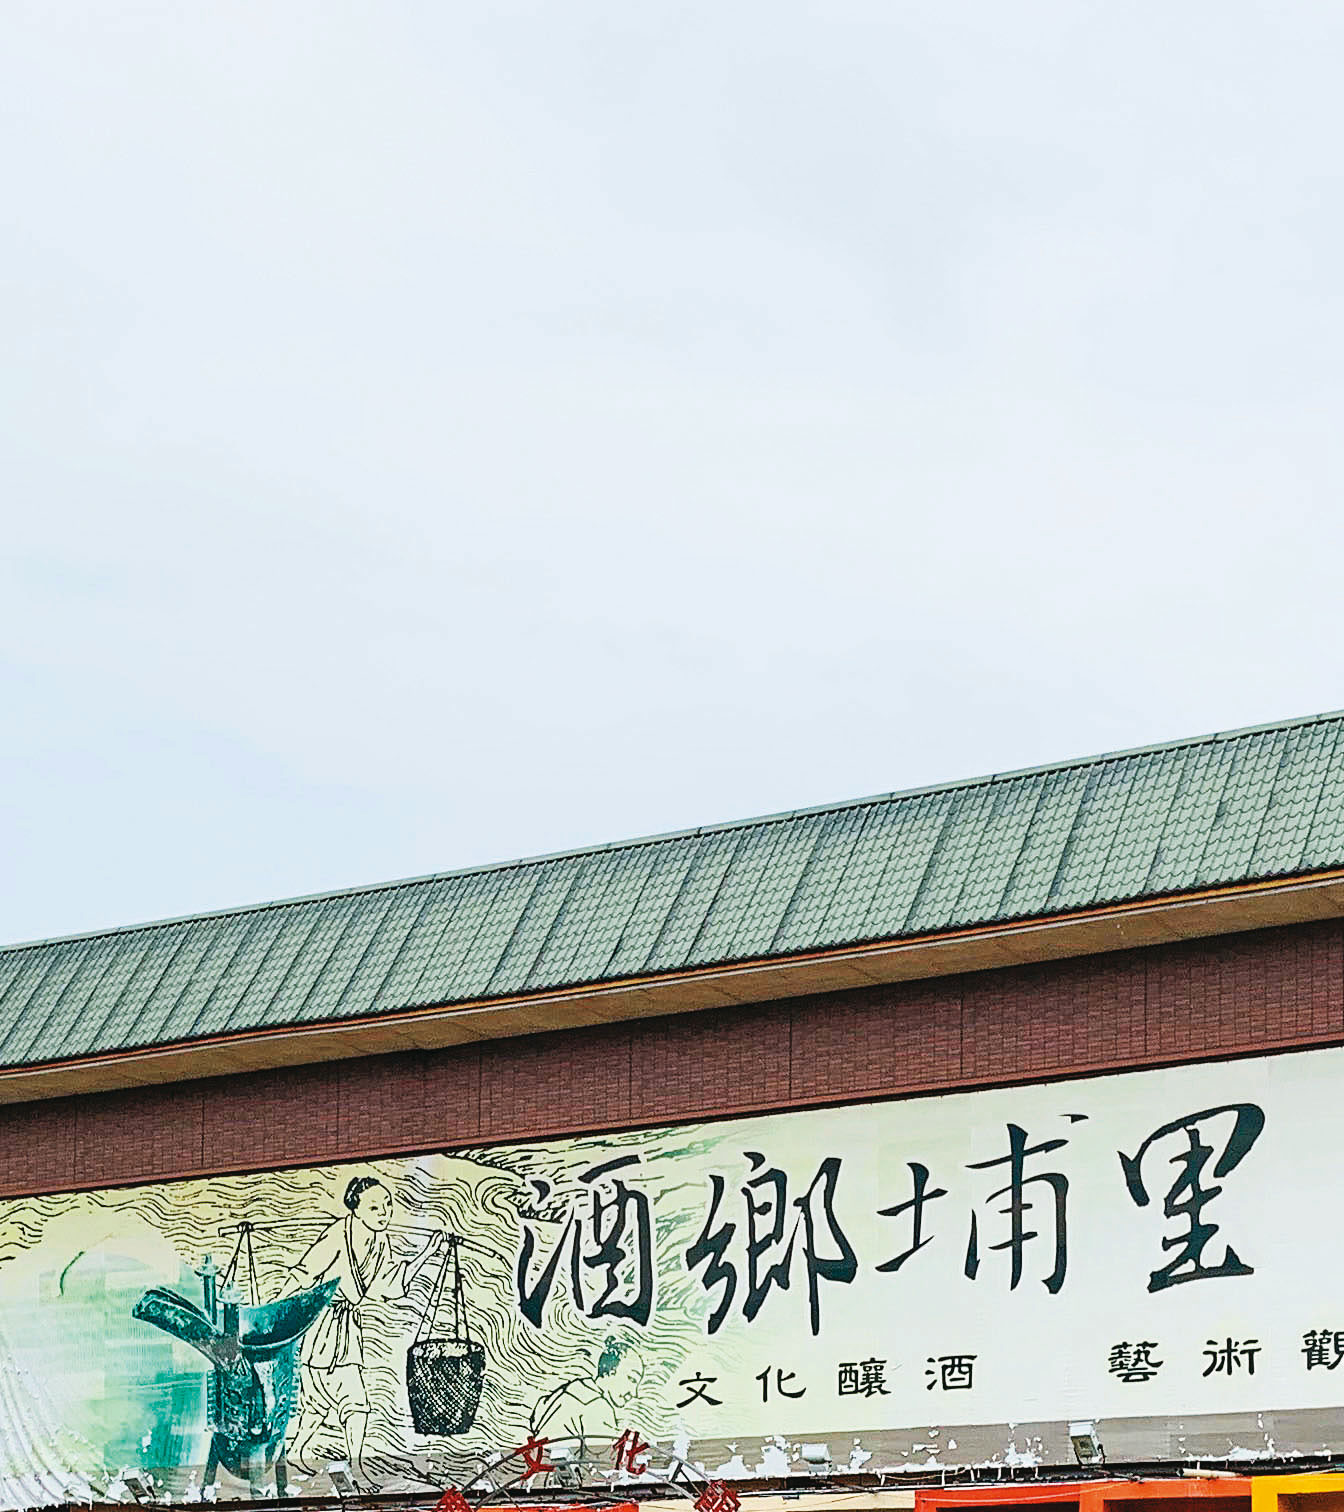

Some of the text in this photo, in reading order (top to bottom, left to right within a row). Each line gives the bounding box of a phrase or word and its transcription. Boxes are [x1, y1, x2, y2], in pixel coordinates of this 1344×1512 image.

[516, 1102, 1267, 1337] 酒鄉埔里
[675, 1352, 978, 1409] 文化釀酒
